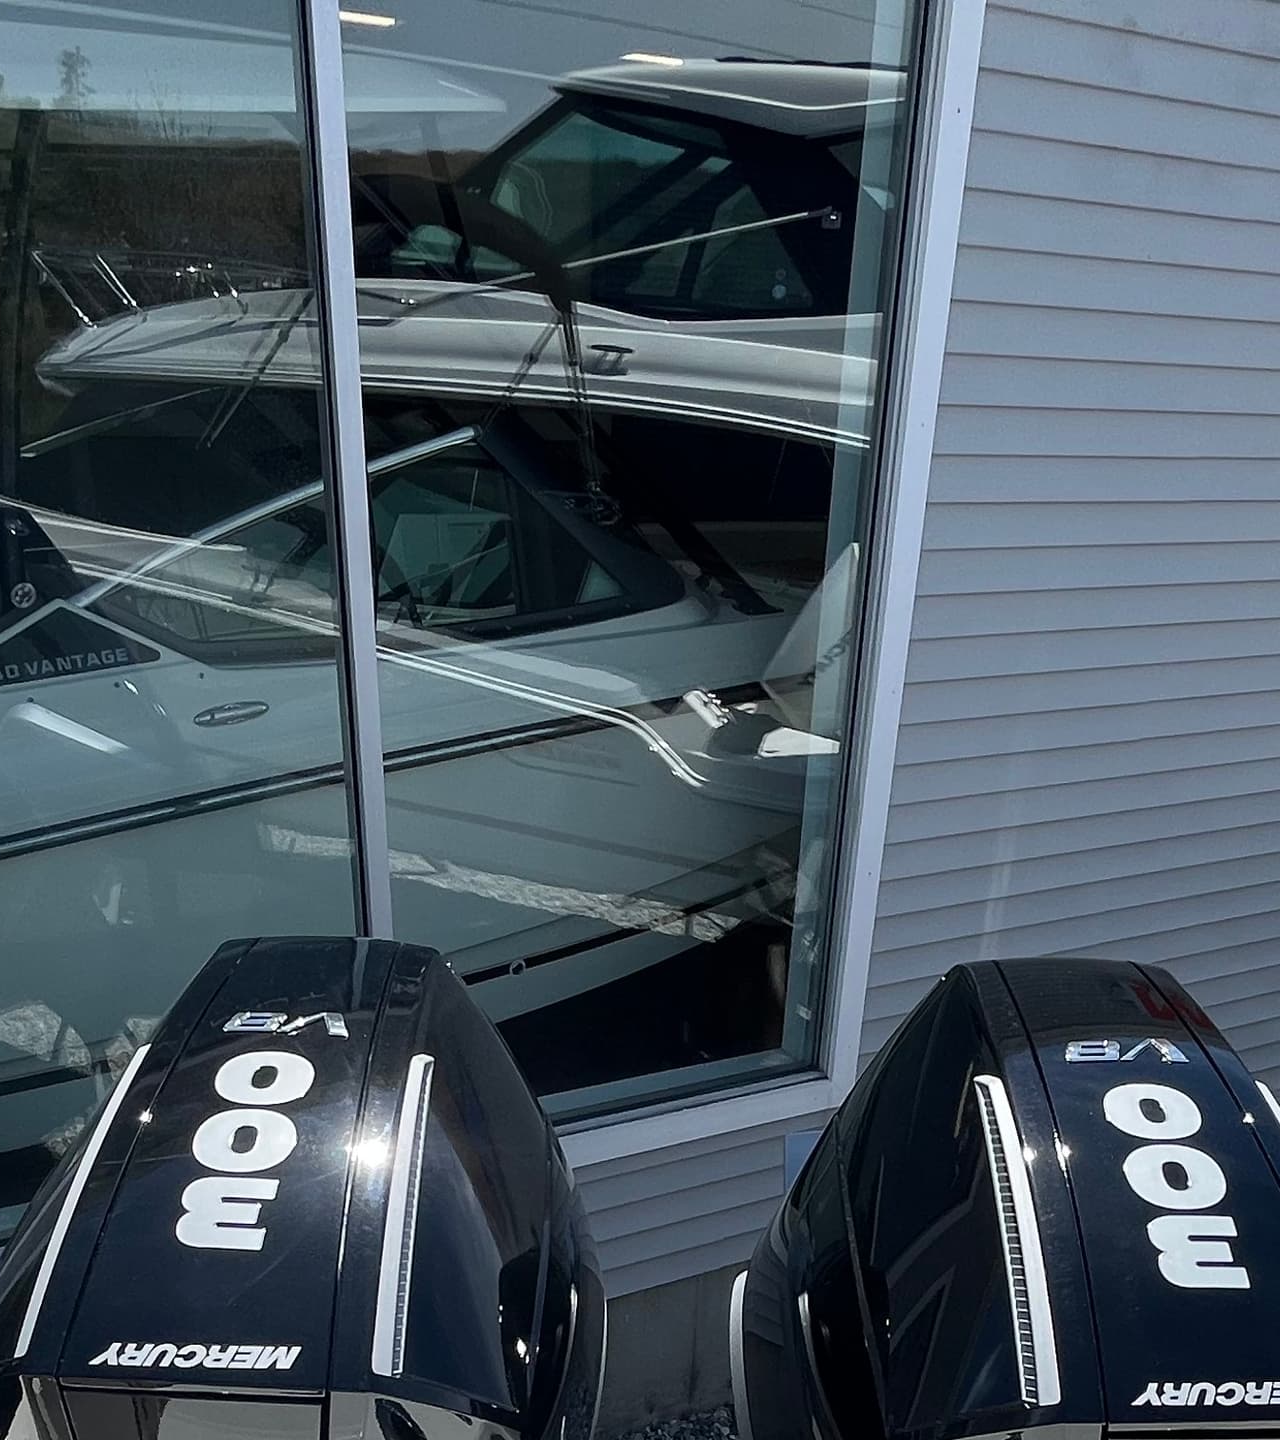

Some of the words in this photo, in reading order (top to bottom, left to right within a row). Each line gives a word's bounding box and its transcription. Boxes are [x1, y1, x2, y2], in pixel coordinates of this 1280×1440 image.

[24, 647, 129, 676] VANTAGE
[222, 1010, 350, 1040] V8
[1064, 1037, 1190, 1064] V8
[175, 1050, 316, 1251] 300
[1102, 1083, 1251, 1289] 300
[89, 1343, 302, 1370] MERCURY
